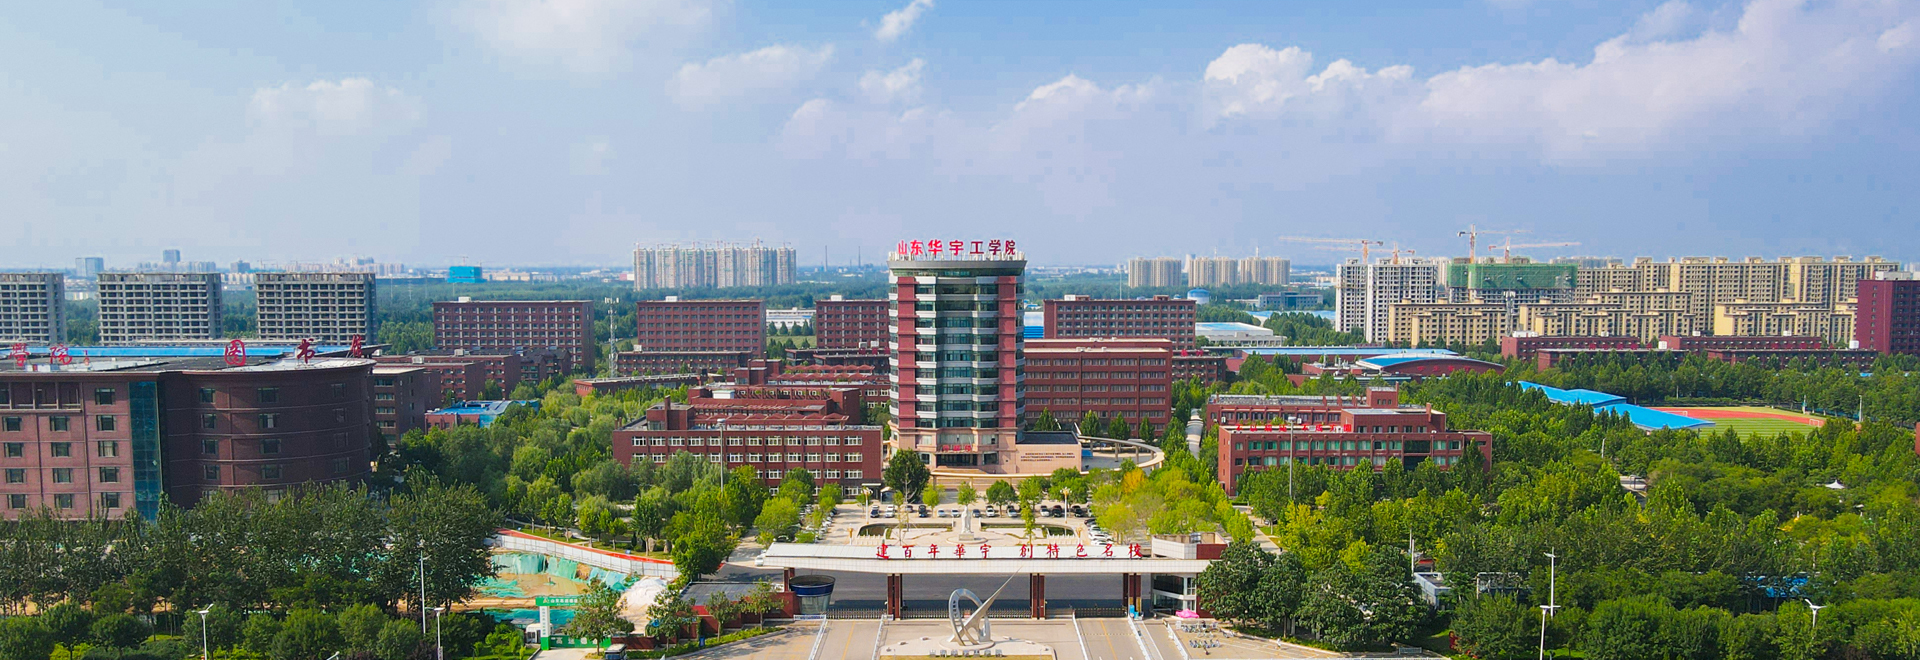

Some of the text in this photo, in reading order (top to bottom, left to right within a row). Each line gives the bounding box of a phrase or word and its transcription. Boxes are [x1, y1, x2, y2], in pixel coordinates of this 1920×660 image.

[898, 240, 1016, 256] 山东华宇工学院
